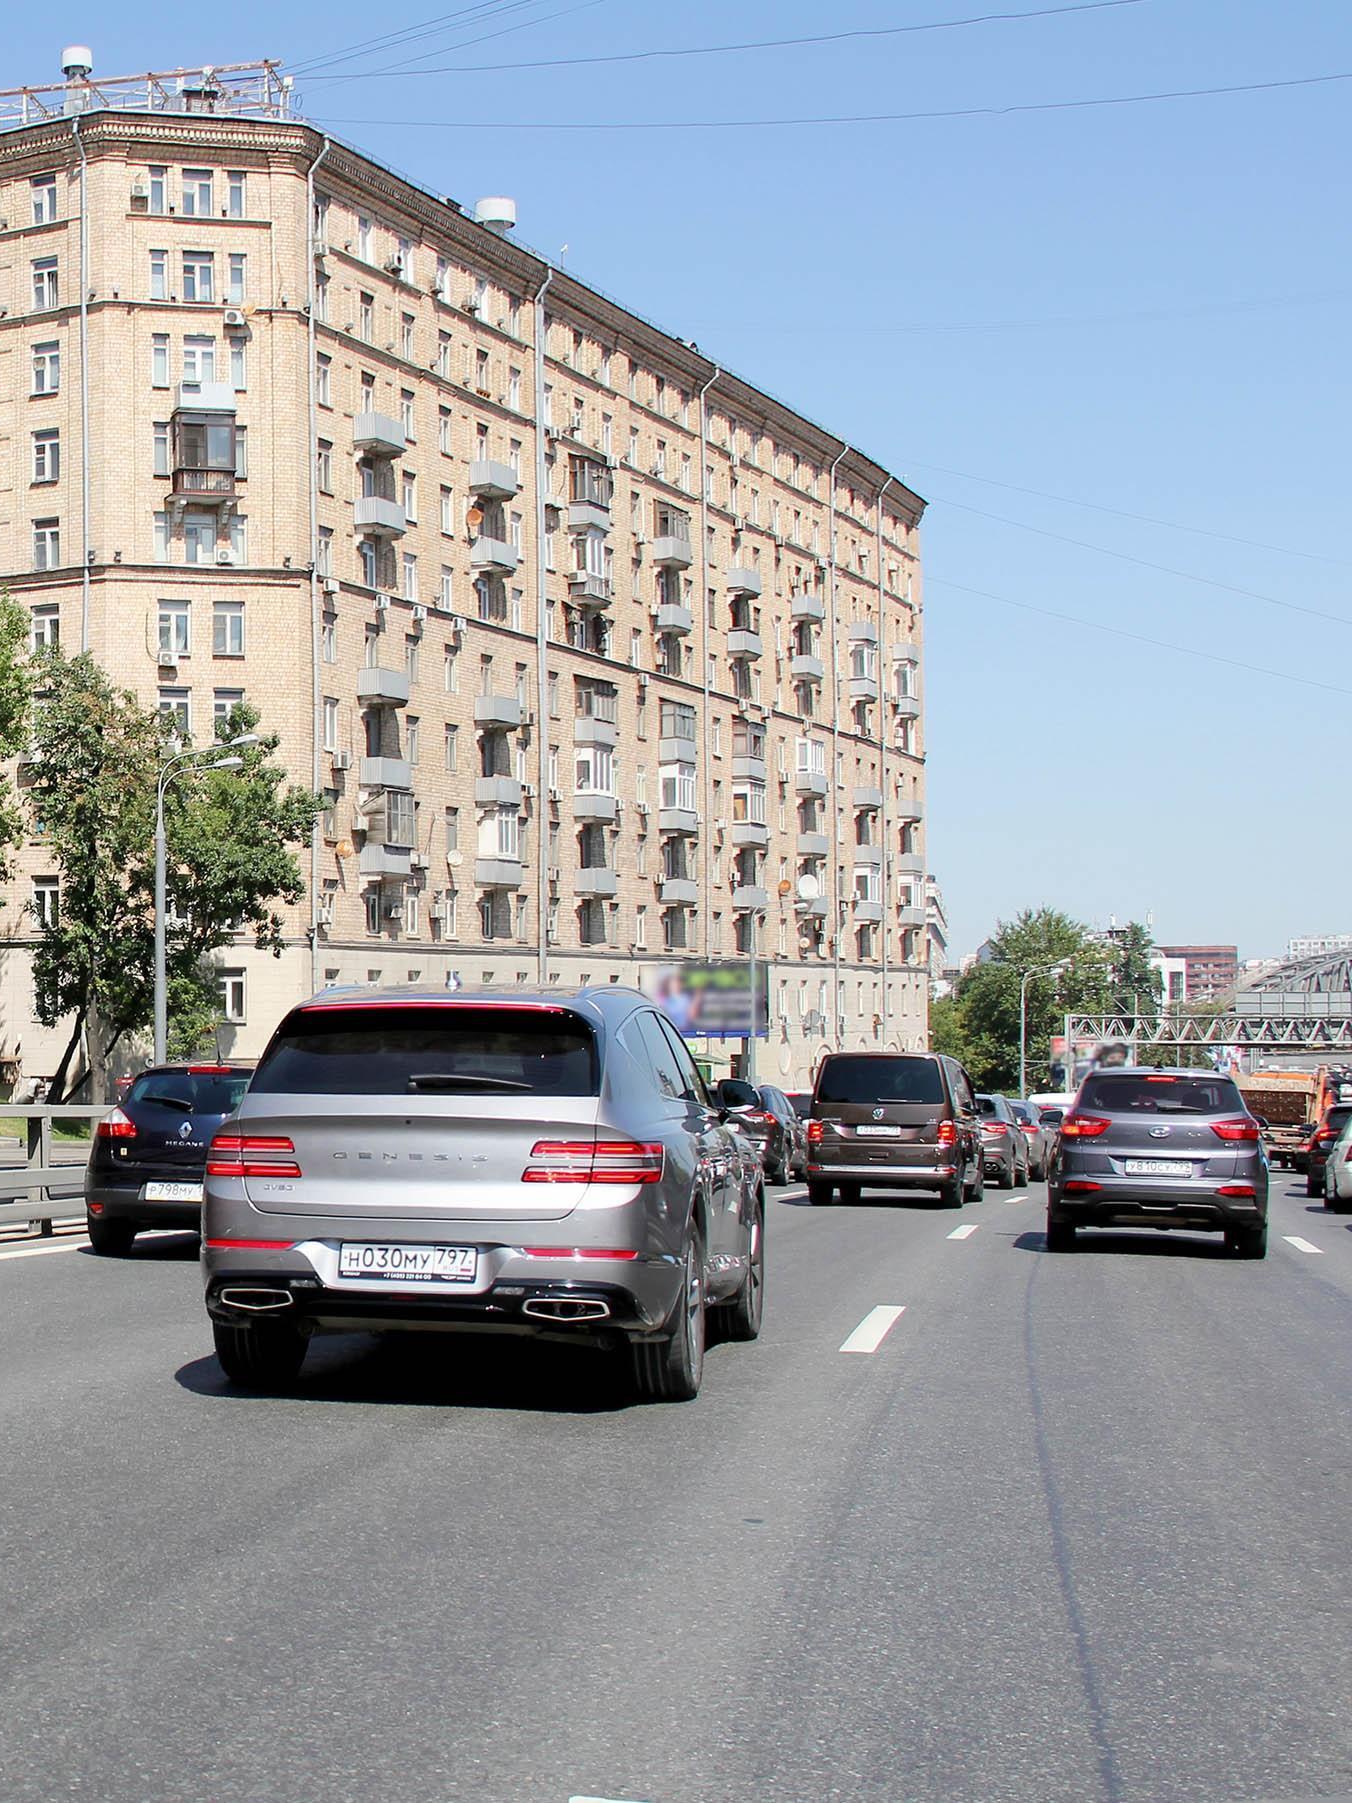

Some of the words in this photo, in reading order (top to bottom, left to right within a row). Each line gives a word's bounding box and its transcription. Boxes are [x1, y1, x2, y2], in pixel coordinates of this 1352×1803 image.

[332, 1152, 489, 1162] GENESIS
[348, 1247, 431, 1269] Н030МУ
[436, 1248, 468, 1266] 797
